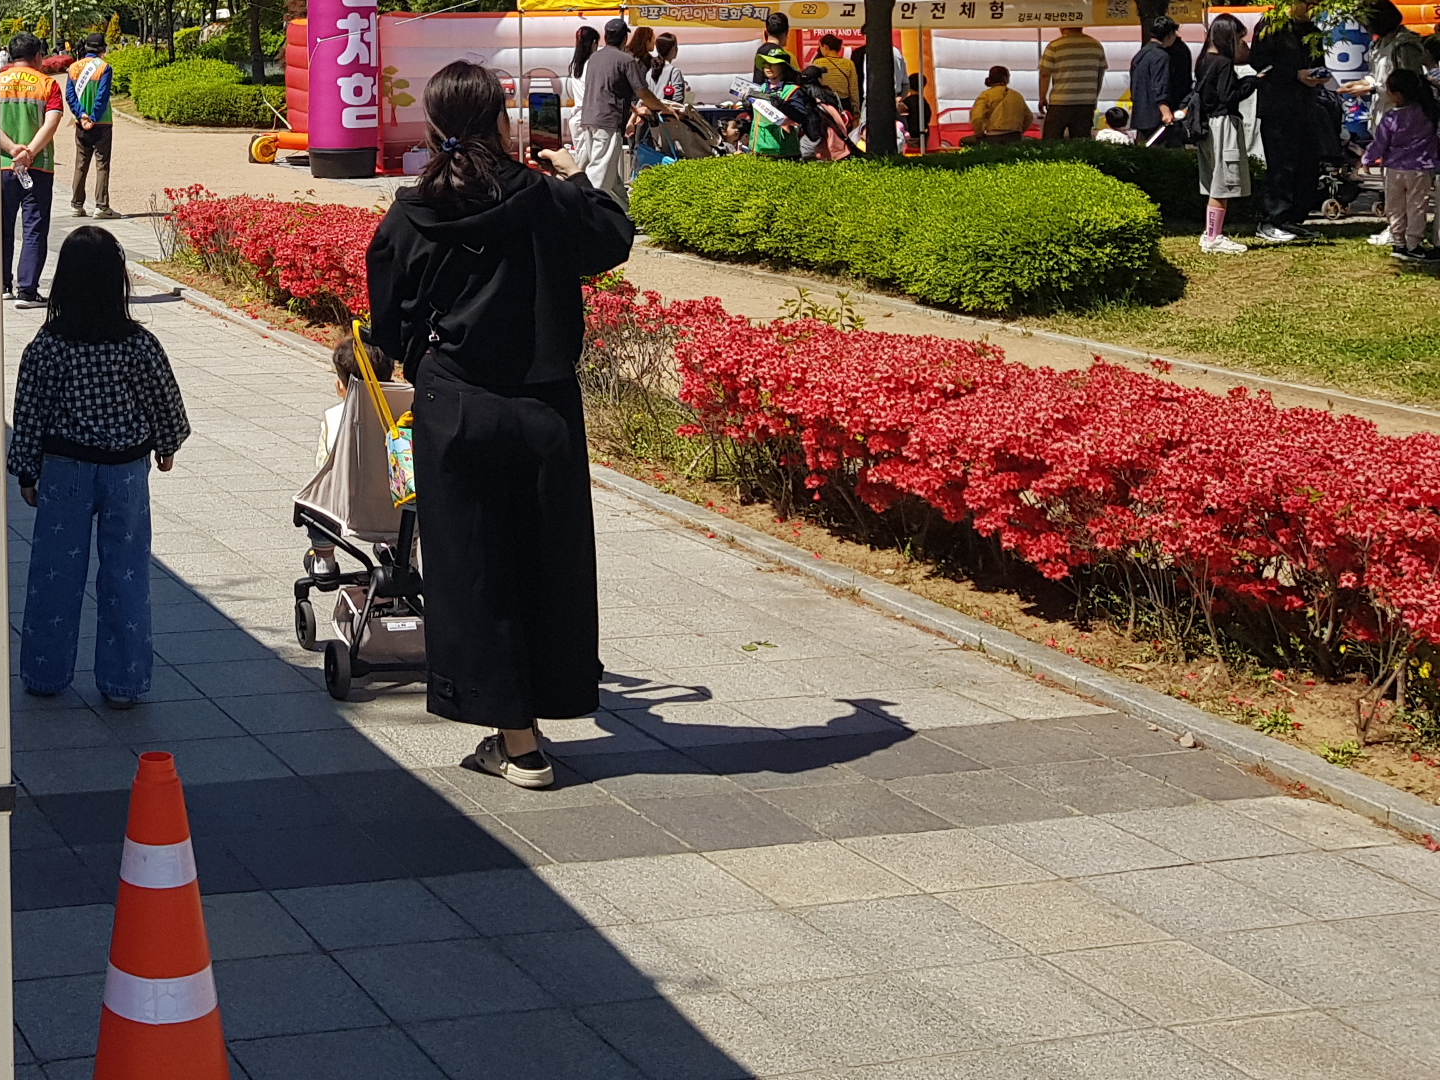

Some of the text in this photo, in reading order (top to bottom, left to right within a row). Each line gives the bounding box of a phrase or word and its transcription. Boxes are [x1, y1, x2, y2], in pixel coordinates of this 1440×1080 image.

[802, 4, 817, 15] 22
[1018, 11, 1083, 22] 김포시 재난안전과
